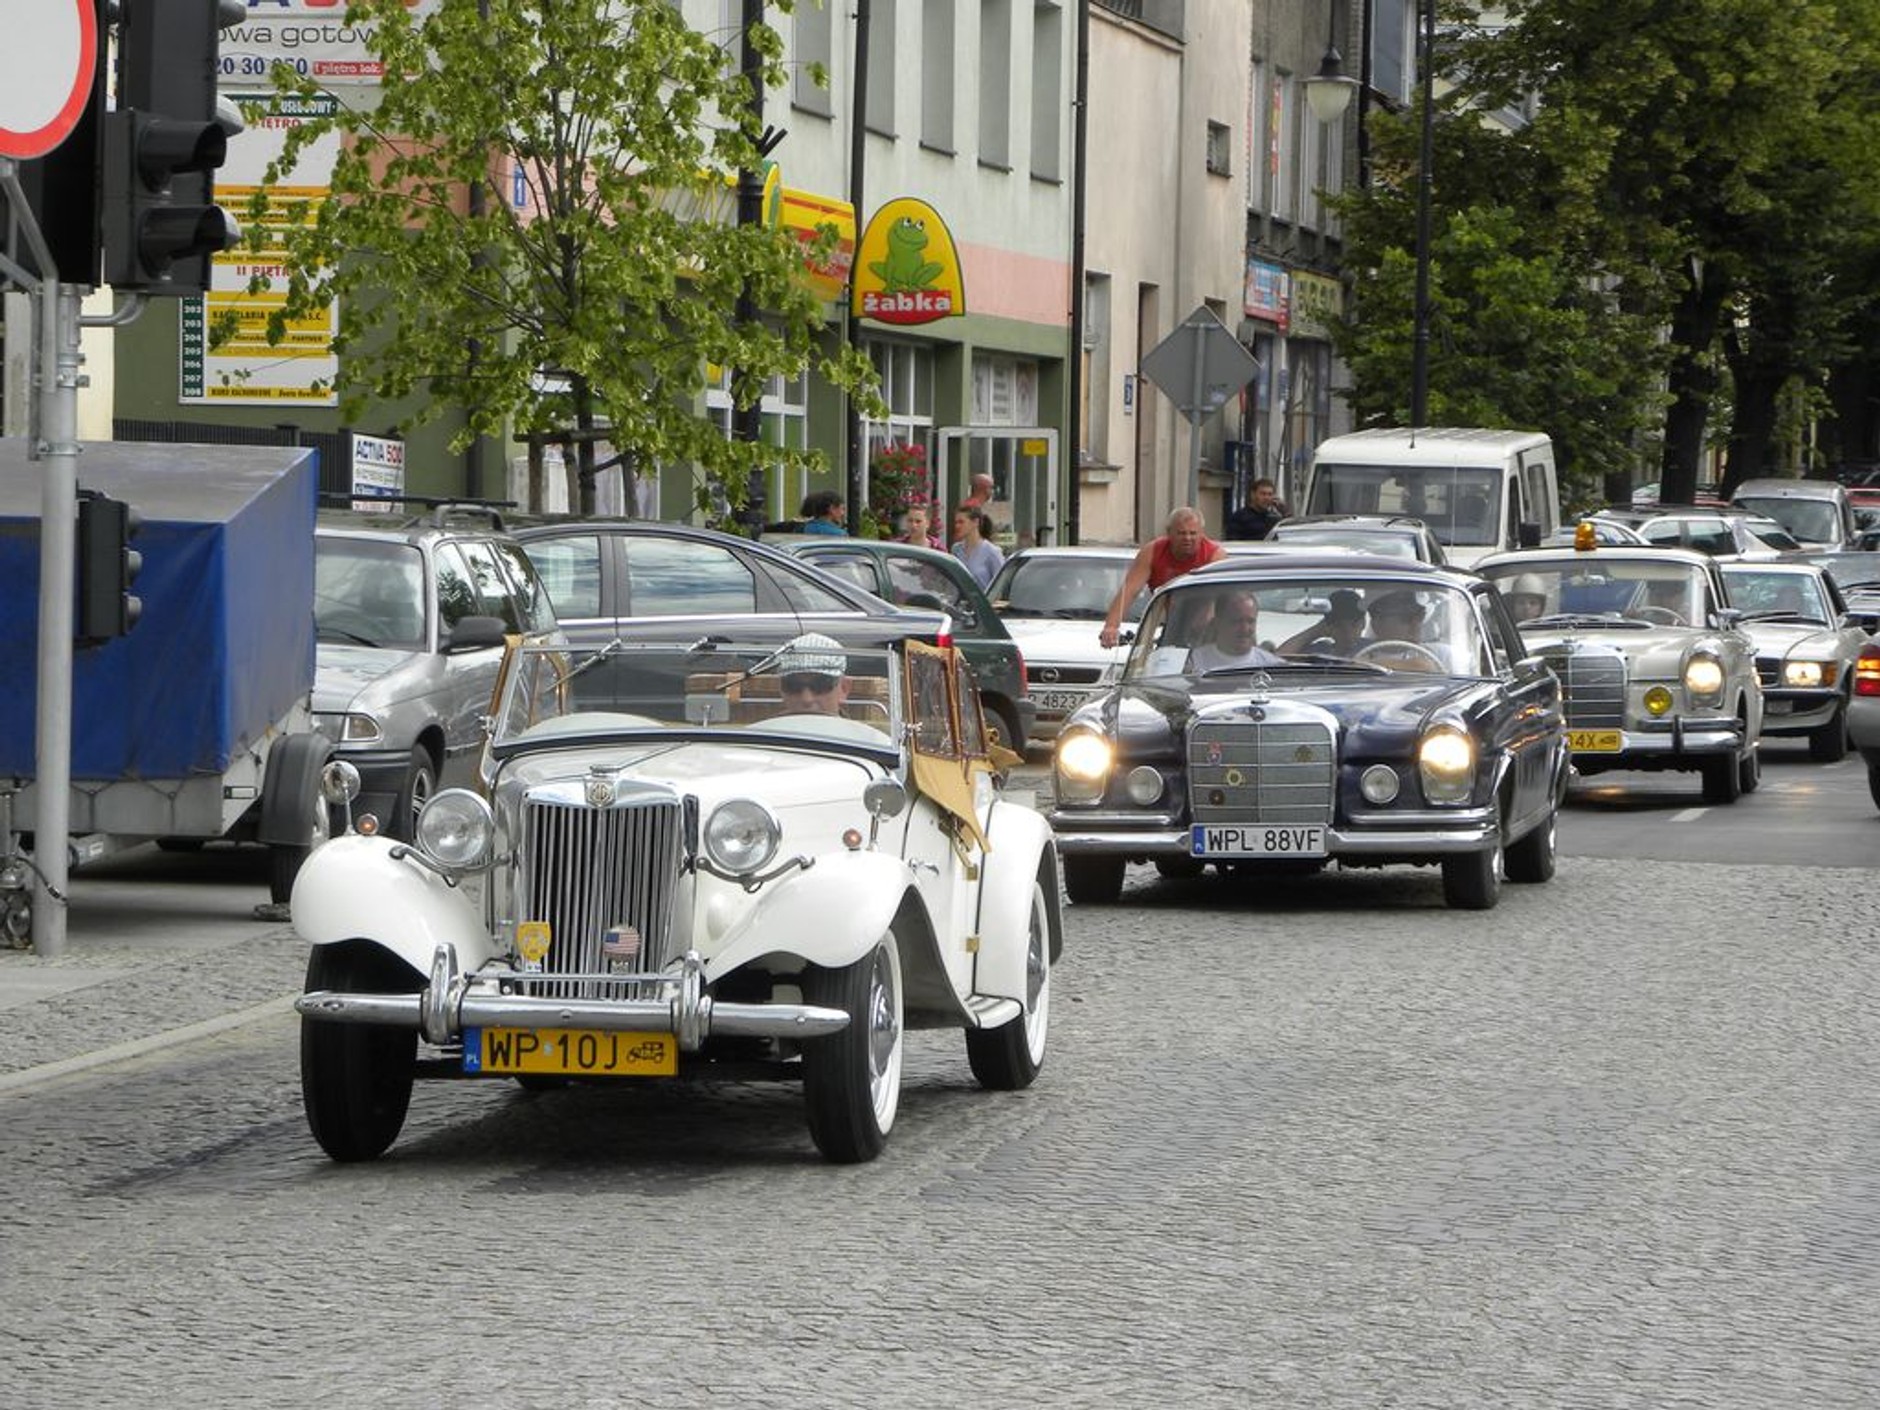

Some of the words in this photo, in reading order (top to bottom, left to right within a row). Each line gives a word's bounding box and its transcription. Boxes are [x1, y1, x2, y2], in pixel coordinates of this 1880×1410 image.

[242, 57, 264, 74] 30
[864, 292, 951, 313] żabka
[1208, 829, 1254, 851] WPL
[1264, 829, 1320, 851] 88VF
[466, 1054, 480, 1065] PL
[488, 1032, 540, 1068] WP
[558, 1034, 618, 1070] 10J
